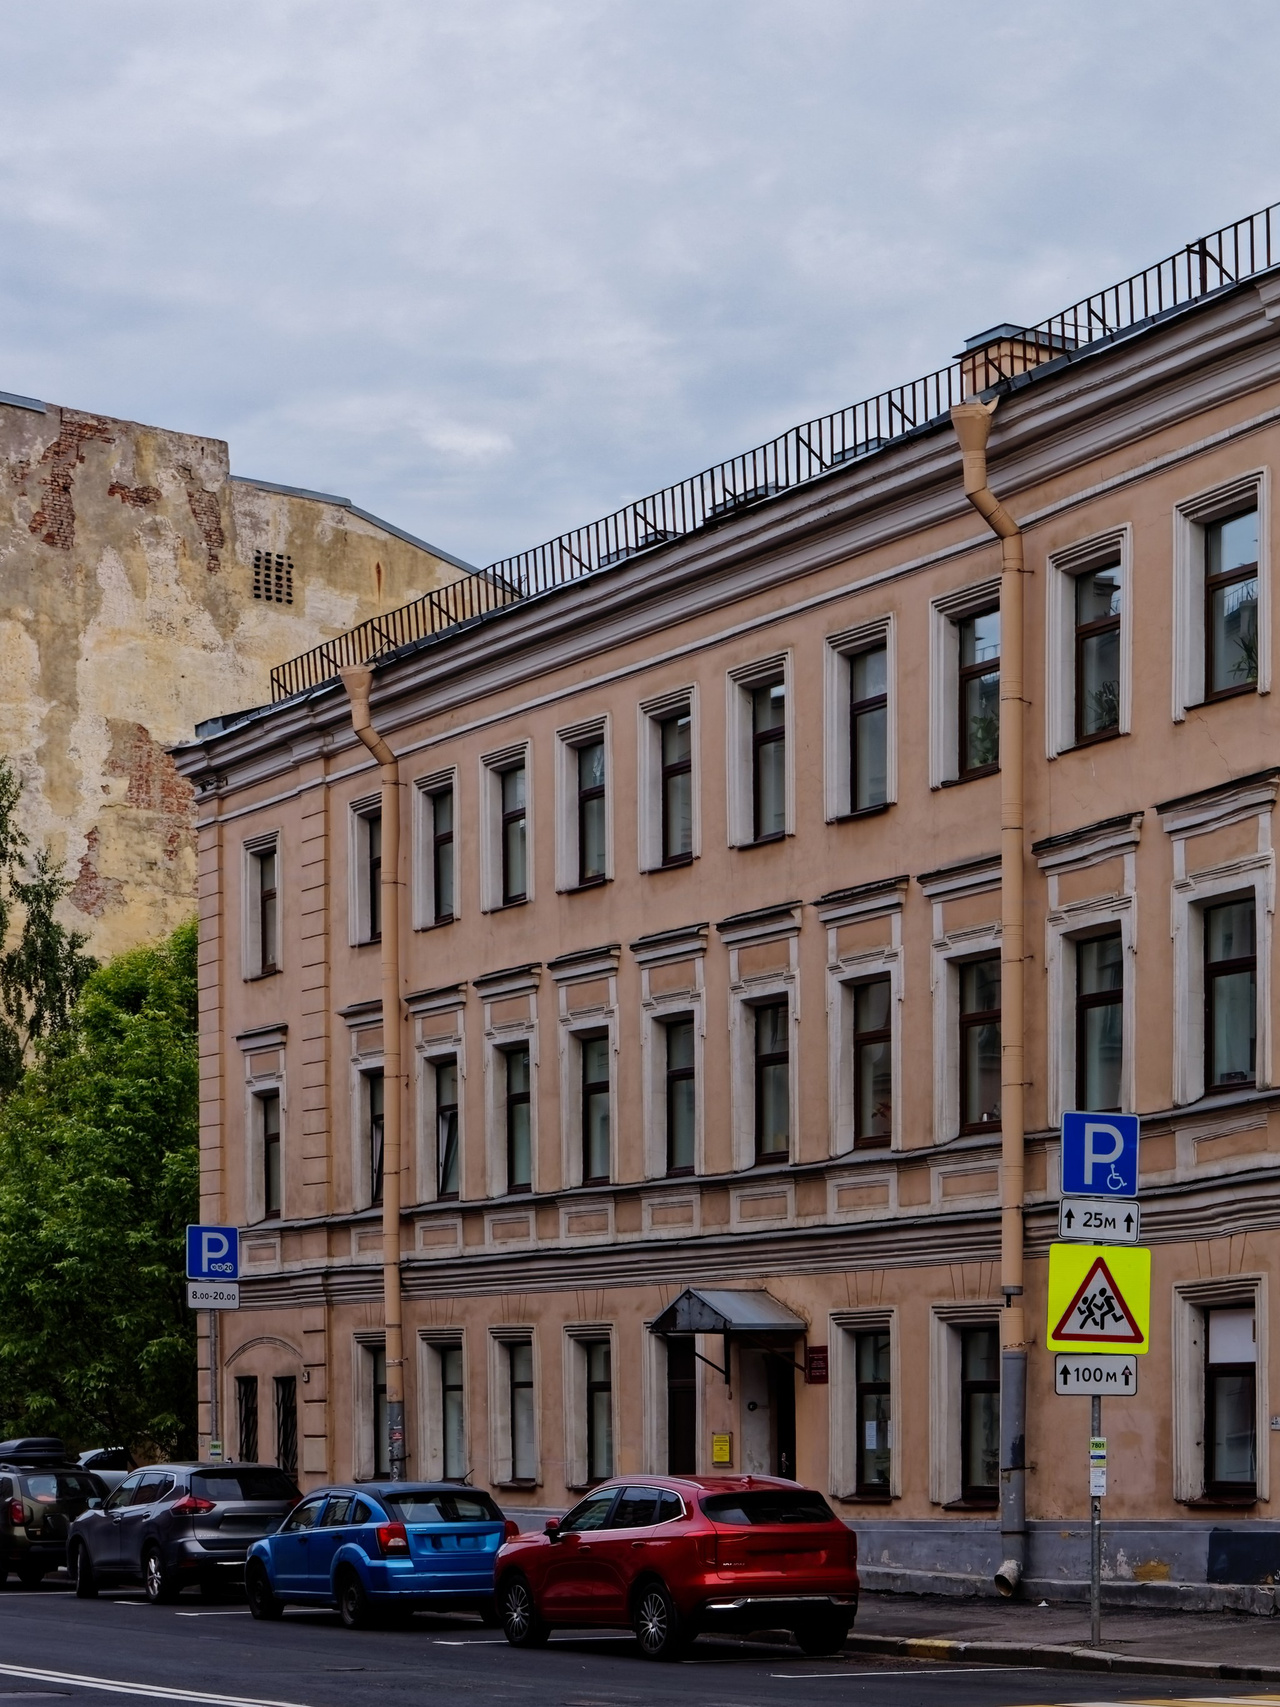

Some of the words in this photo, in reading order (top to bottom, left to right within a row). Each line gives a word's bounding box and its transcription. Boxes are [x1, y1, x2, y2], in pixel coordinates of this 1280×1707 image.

[1084, 1122, 1125, 1185] P
[202, 1232, 229, 1273] P
[192, 1291, 236, 1300] 8.00-20.00
